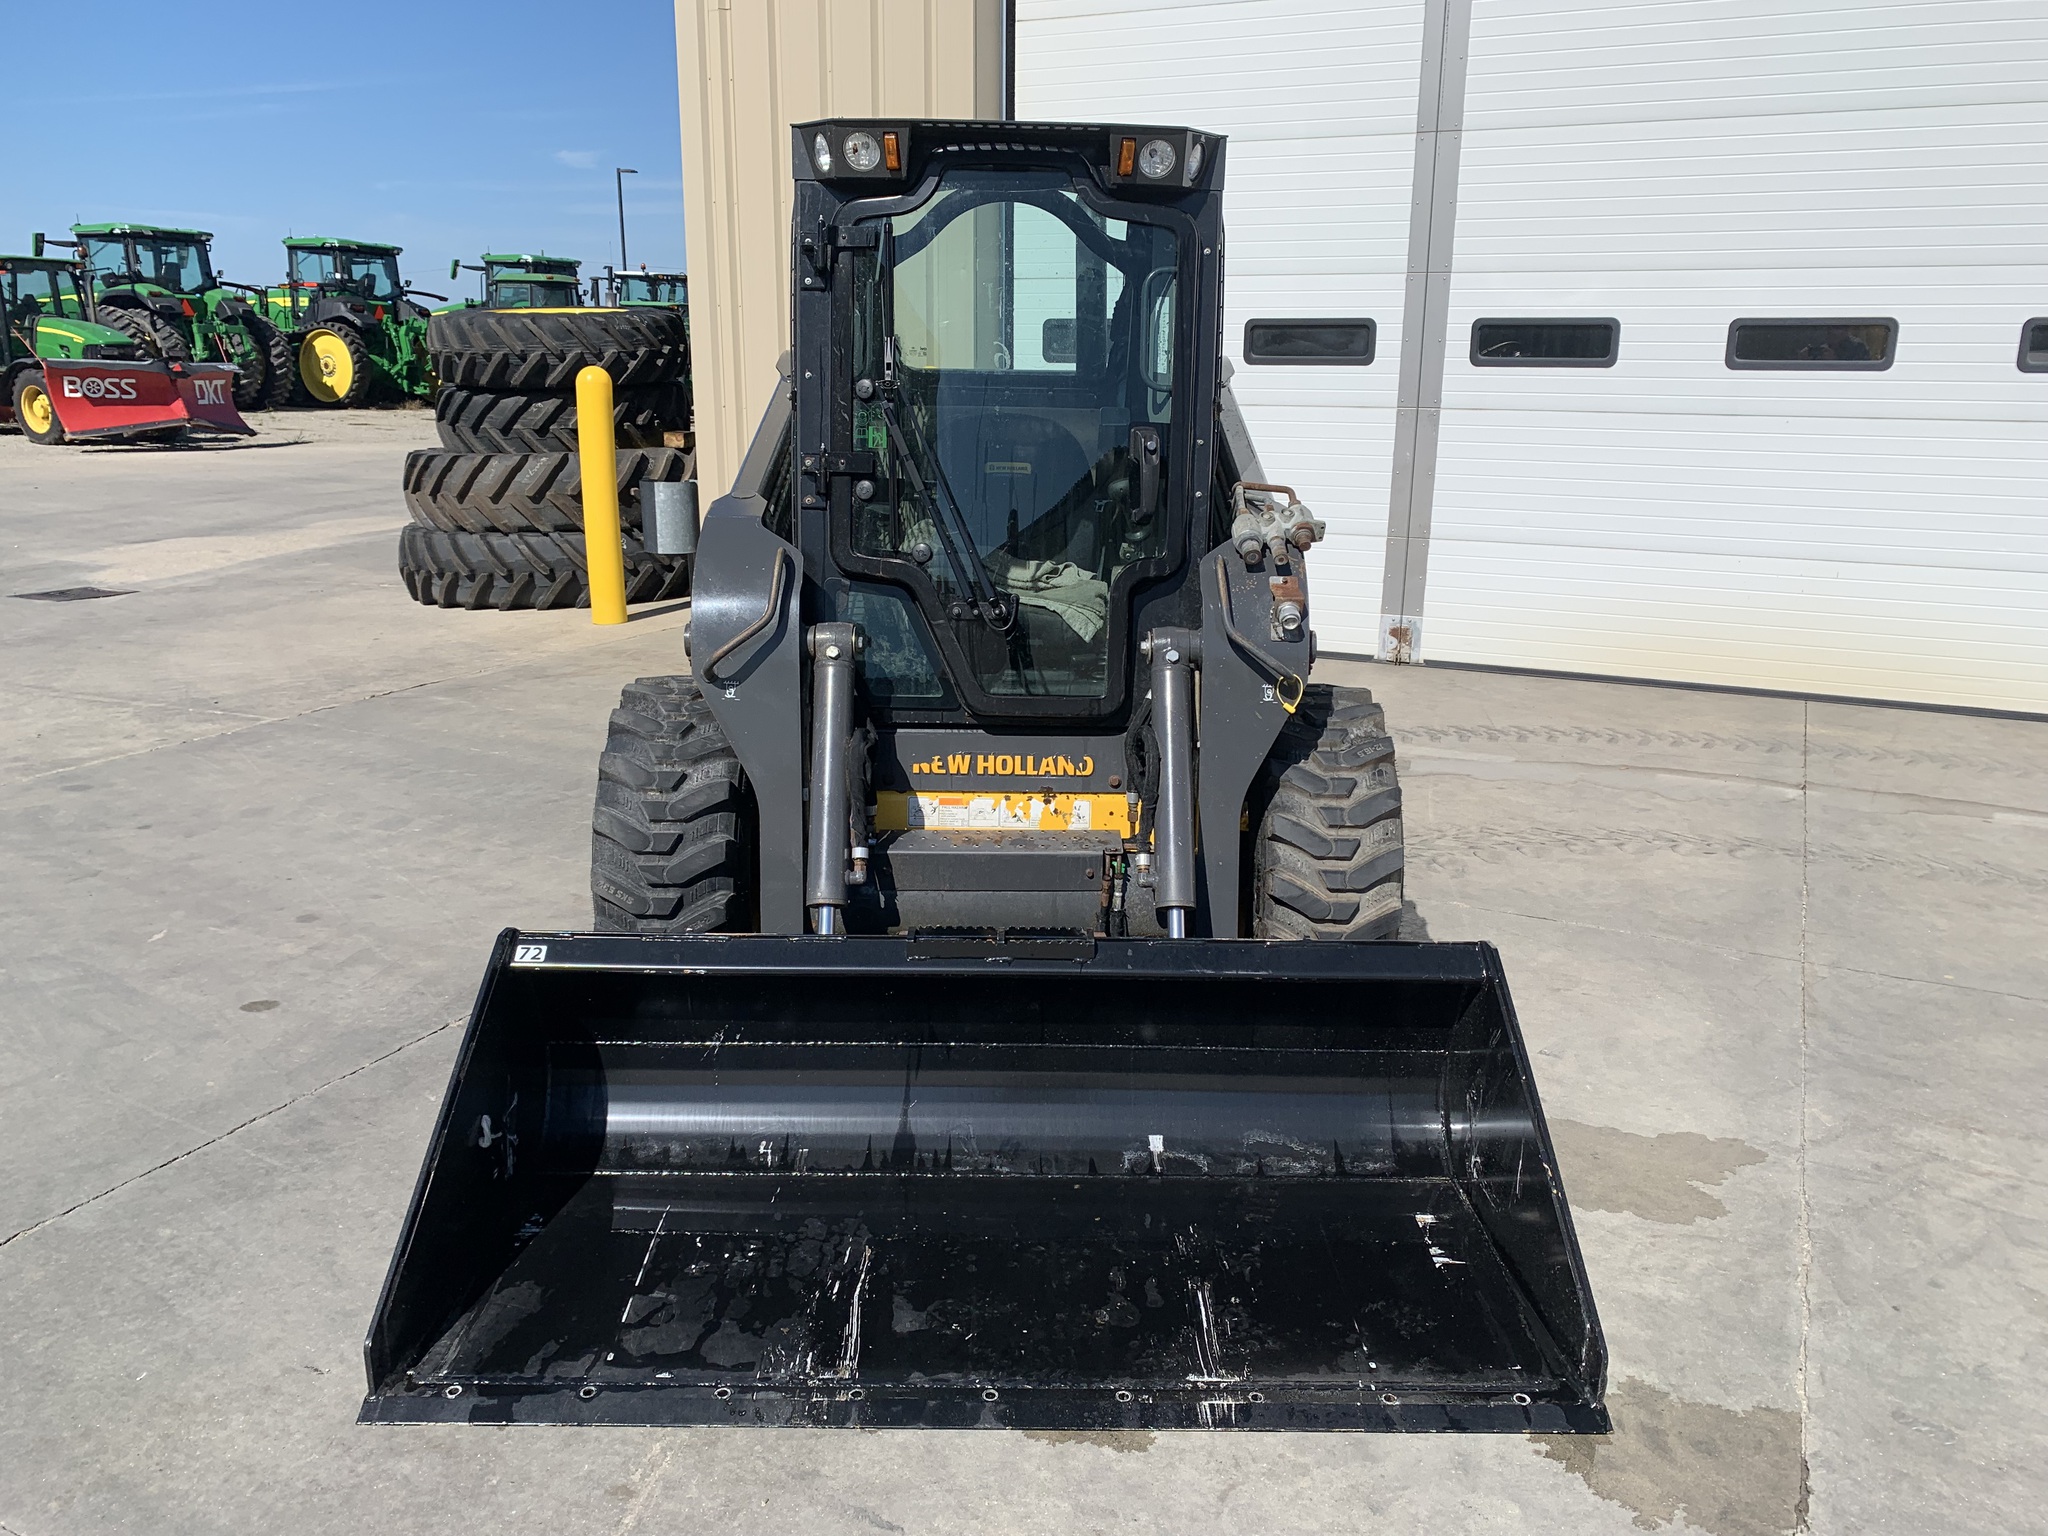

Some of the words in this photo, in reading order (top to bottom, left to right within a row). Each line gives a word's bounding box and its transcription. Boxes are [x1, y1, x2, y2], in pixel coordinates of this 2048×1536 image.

[62, 375, 137, 400] BOSS
[976, 754, 1094, 776] HOLLAND
[615, 889, 634, 904] SKS
[519, 946, 543, 960] 72
